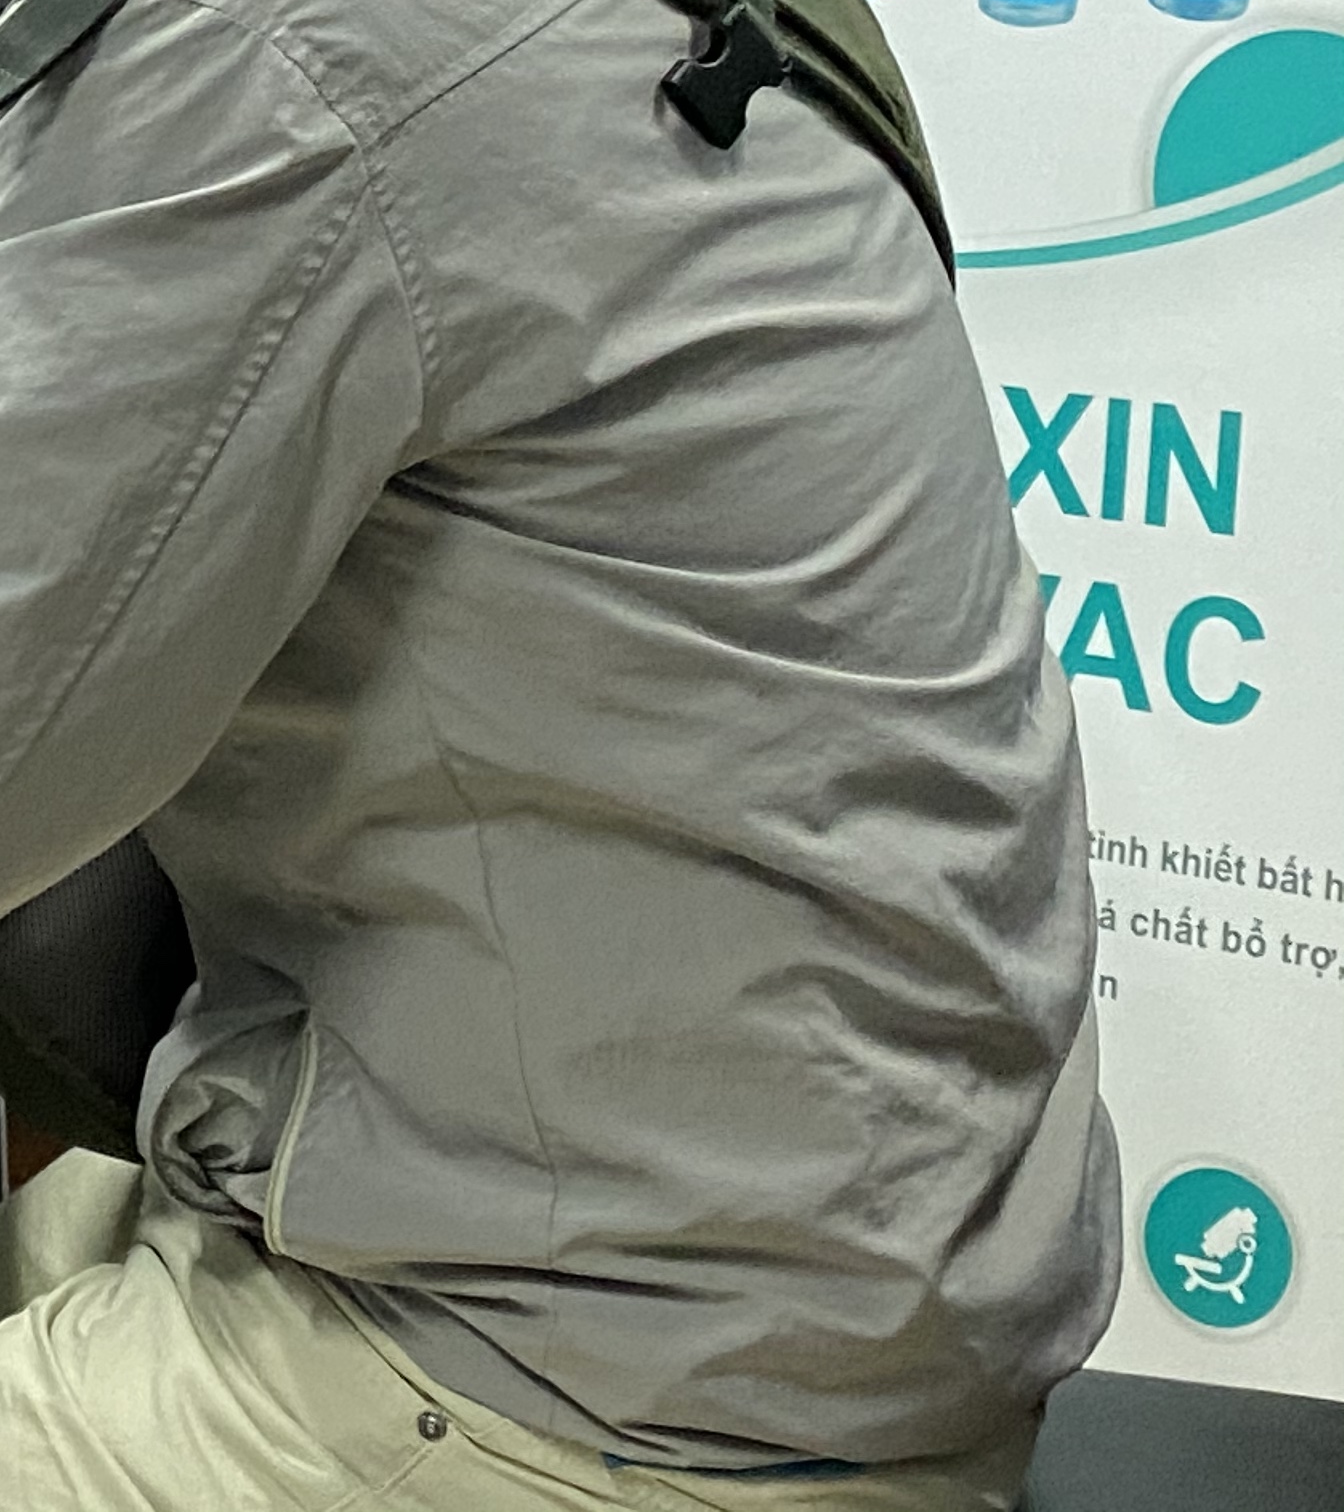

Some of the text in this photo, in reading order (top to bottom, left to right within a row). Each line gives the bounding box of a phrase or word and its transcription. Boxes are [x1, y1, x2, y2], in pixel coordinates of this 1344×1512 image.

[1001, 384, 1242, 536] XIN
[1040, 573, 1265, 725] AC
[1161, 841, 1246, 886] khiết
[1258, 854, 1313, 897] bất
[1130, 905, 1208, 948] chất
[1222, 916, 1266, 957] bổ
